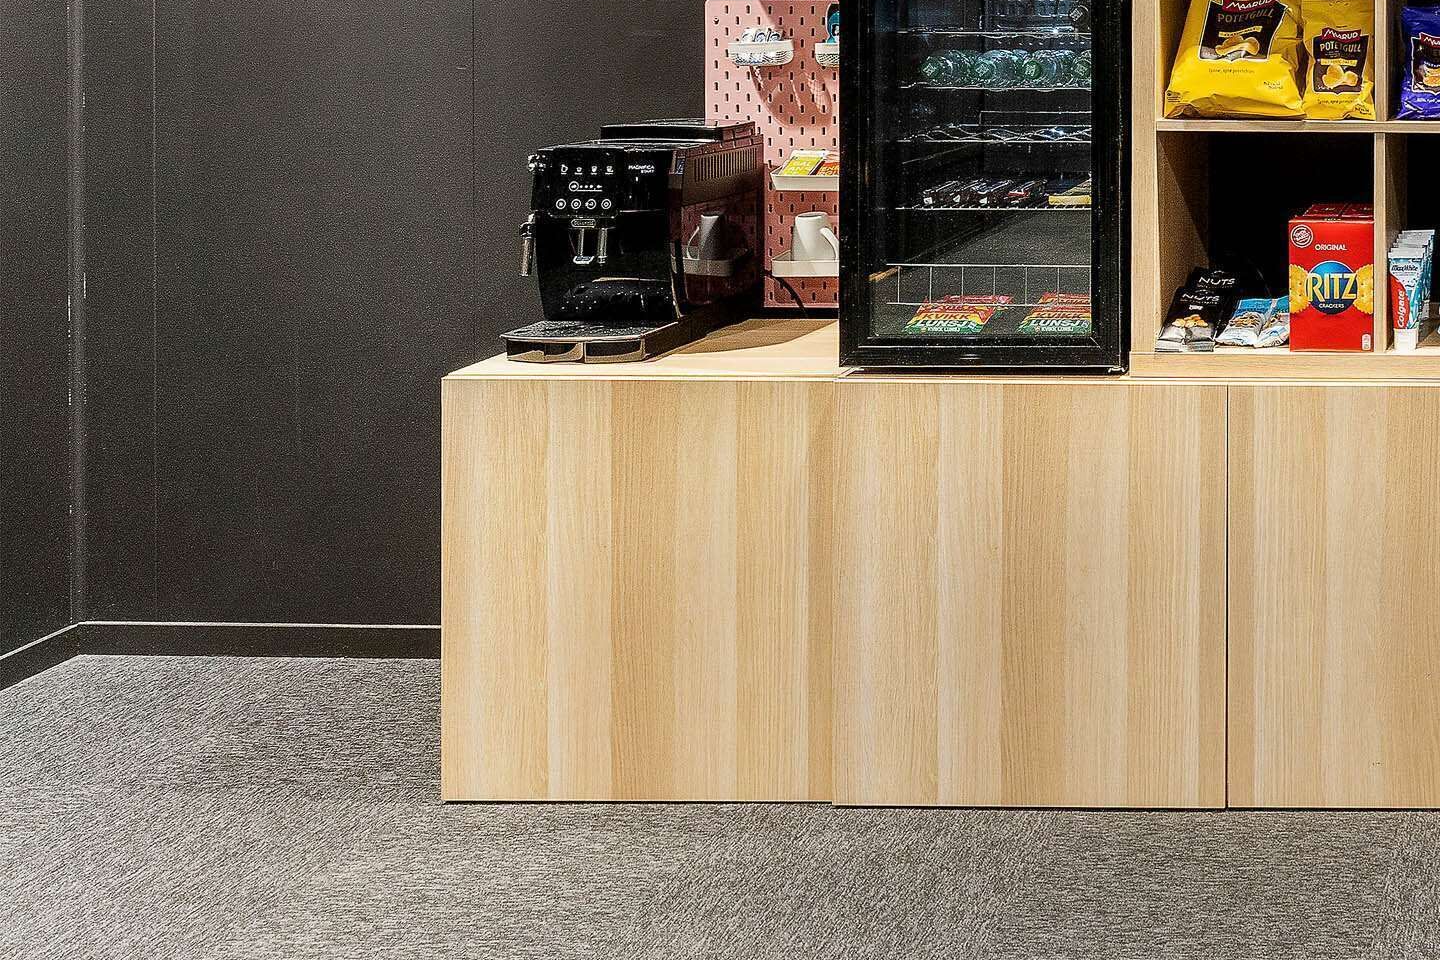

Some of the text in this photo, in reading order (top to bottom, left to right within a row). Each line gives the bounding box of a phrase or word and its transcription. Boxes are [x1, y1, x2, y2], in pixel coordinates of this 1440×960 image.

[1217, 8, 1275, 23] POTETGULL
[1314, 243, 1347, 251] ORIGINAL
[1198, 276, 1236, 286] NUTS
[1307, 272, 1358, 303] RITZ
[1181, 293, 1221, 302] NUTS
[1397, 289, 1407, 328] Colgate
[1031, 319, 1080, 327] LUNSJ
